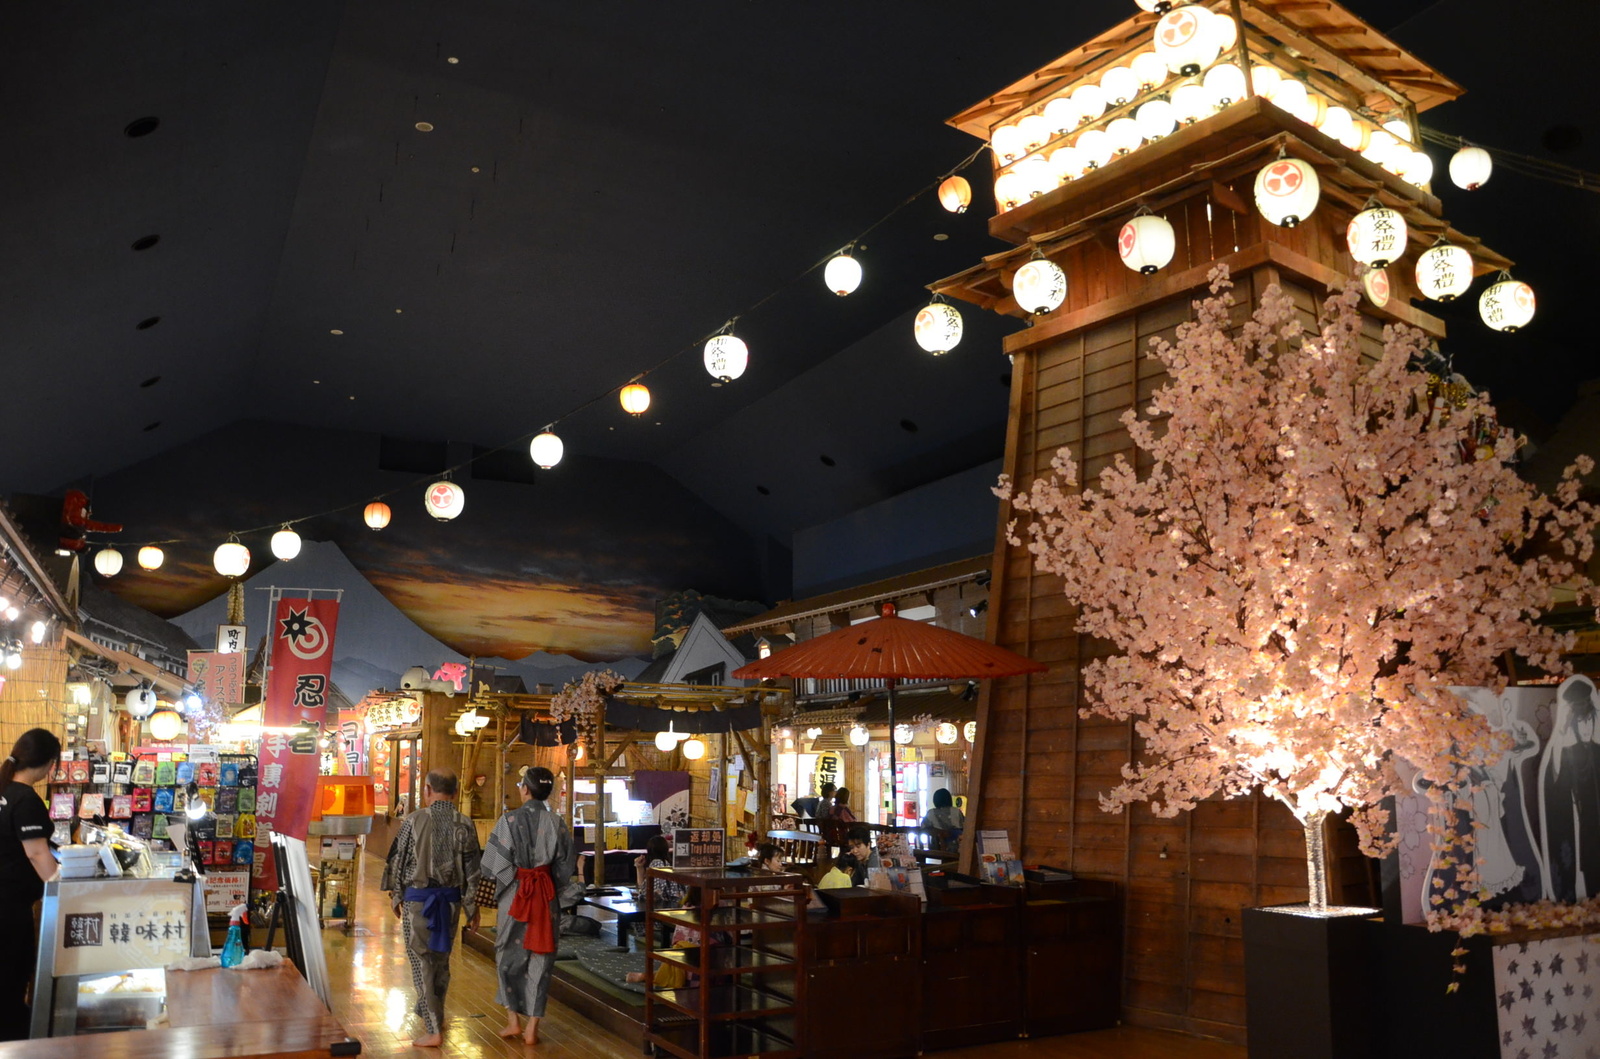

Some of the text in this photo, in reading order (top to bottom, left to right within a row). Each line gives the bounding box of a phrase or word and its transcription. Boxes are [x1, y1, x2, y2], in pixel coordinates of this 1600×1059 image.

[288, 674, 326, 755] 忍者
[109, 920, 186, 944] 韓味村
